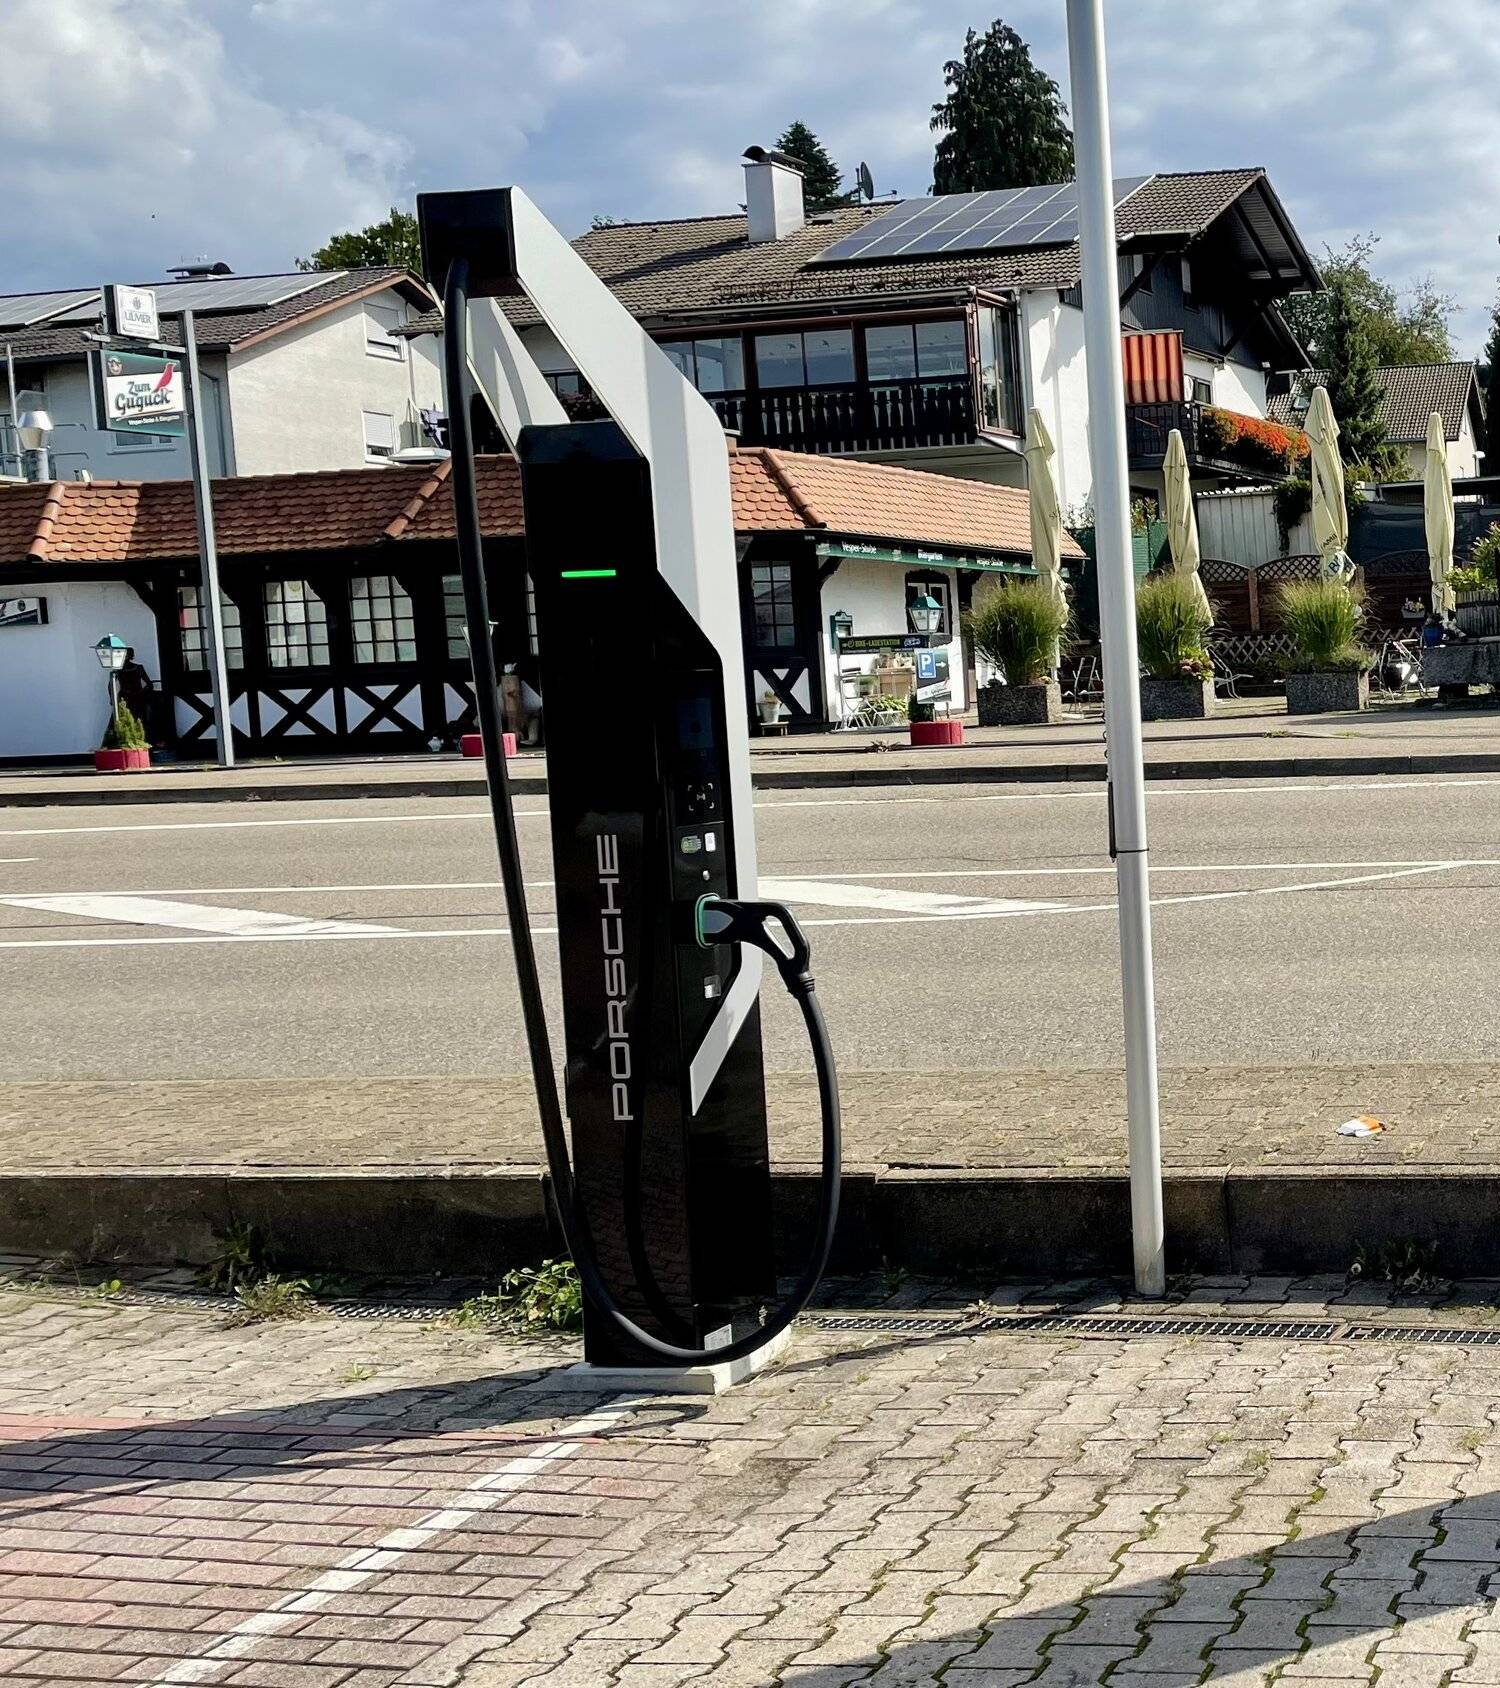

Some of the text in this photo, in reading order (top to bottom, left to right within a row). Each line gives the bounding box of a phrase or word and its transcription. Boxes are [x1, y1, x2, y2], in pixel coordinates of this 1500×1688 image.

[127, 381, 151, 396] Zum
[114, 389, 171, 415] Guguck
[921, 654, 931, 671] P
[596, 834, 634, 1121] PORSCHE
